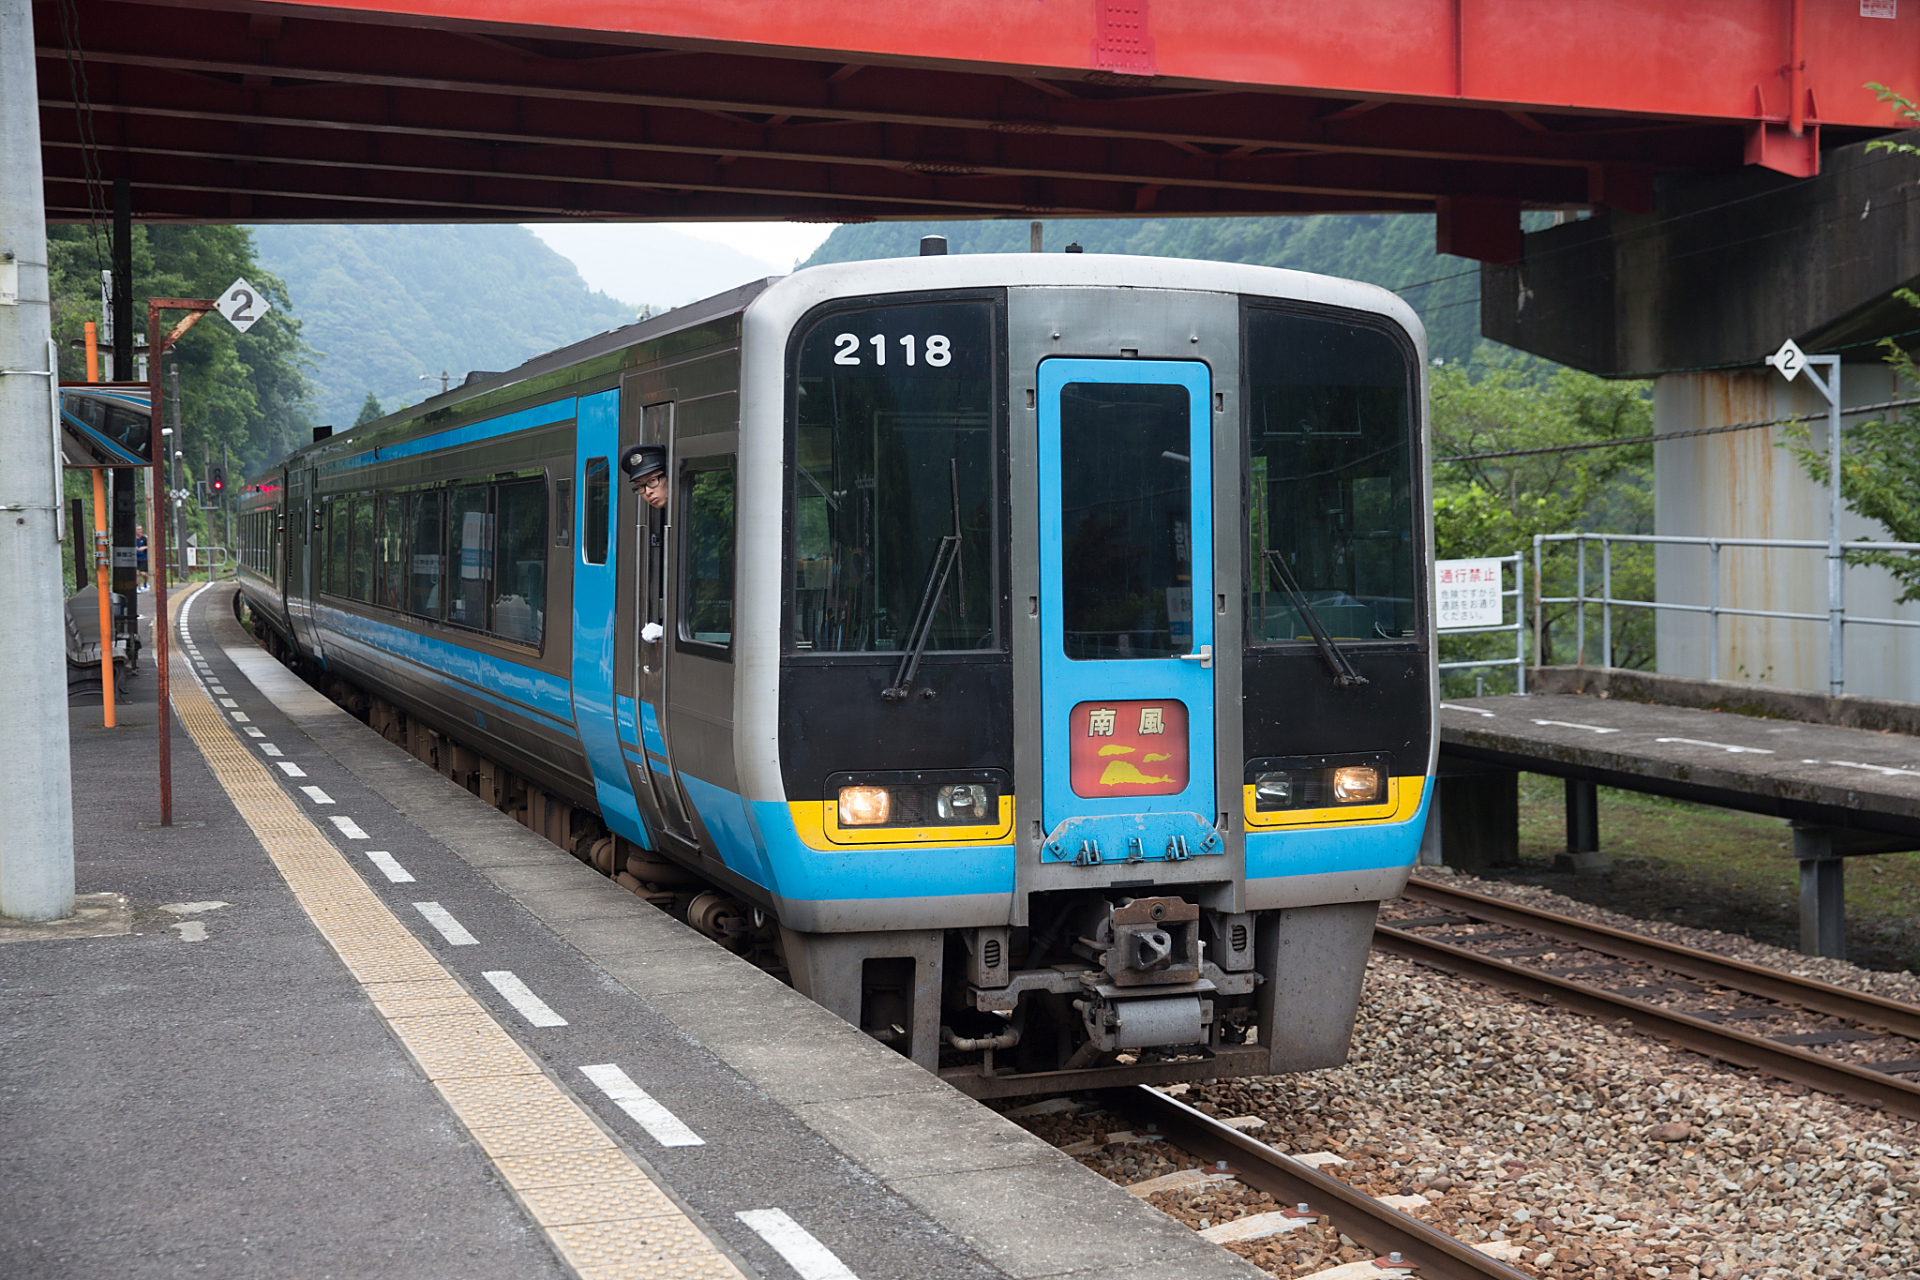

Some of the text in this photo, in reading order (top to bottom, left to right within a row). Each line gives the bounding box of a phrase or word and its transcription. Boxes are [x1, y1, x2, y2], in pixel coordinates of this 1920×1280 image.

[230, 289, 255, 321] 2
[833, 333, 952, 367] 2118
[1784, 349, 1796, 370] 2
[1440, 567, 1496, 583] 通行禁止
[1441, 588, 1496, 599] 危険ですから
[1088, 707, 1166, 738] 南風
